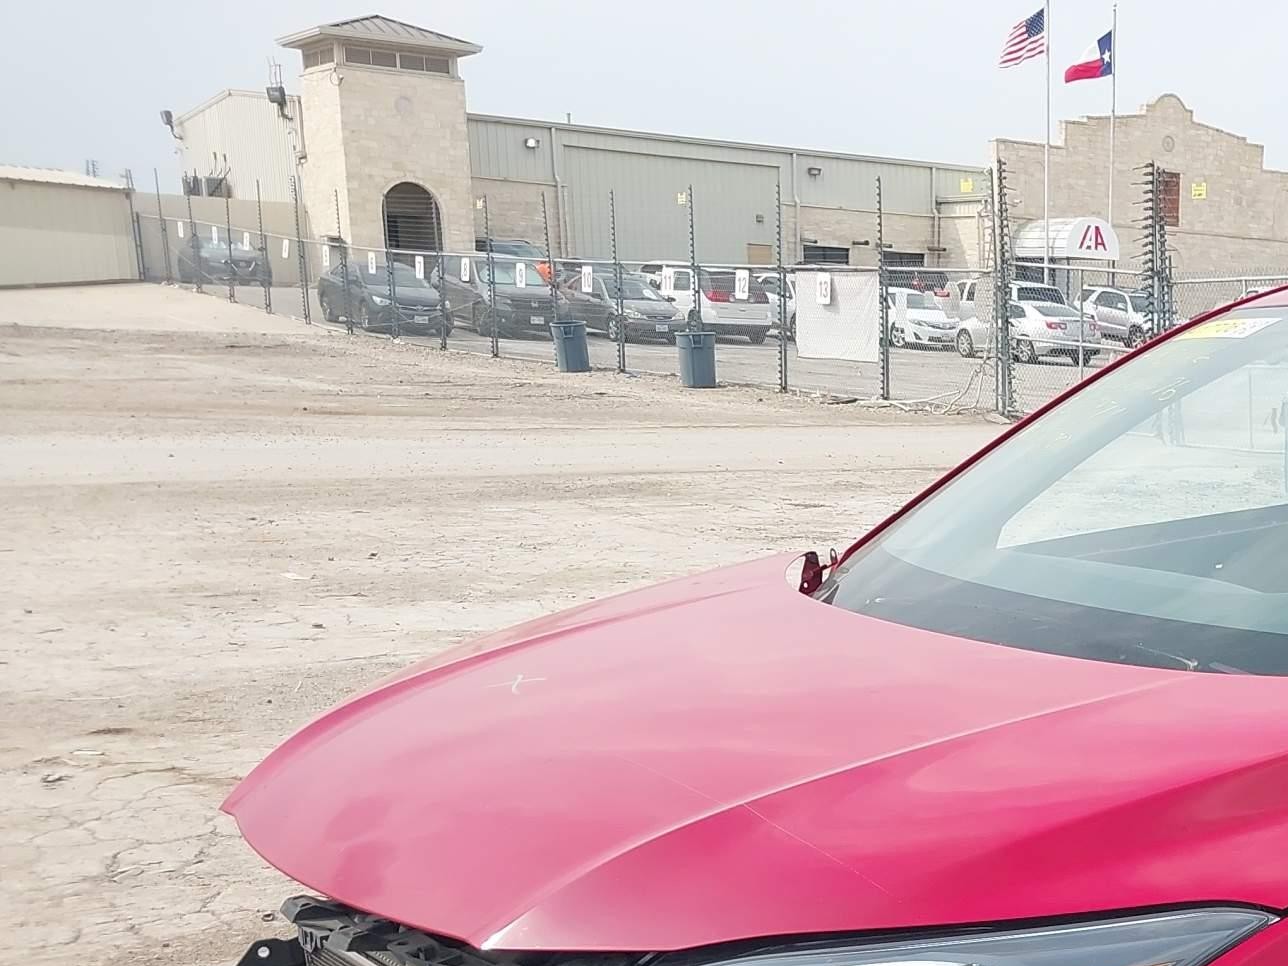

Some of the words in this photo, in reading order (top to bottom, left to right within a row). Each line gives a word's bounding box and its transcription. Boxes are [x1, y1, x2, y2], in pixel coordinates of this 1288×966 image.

[582, 270, 593, 289] 10
[737, 276, 748, 294] 12
[818, 280, 829, 298] 13
